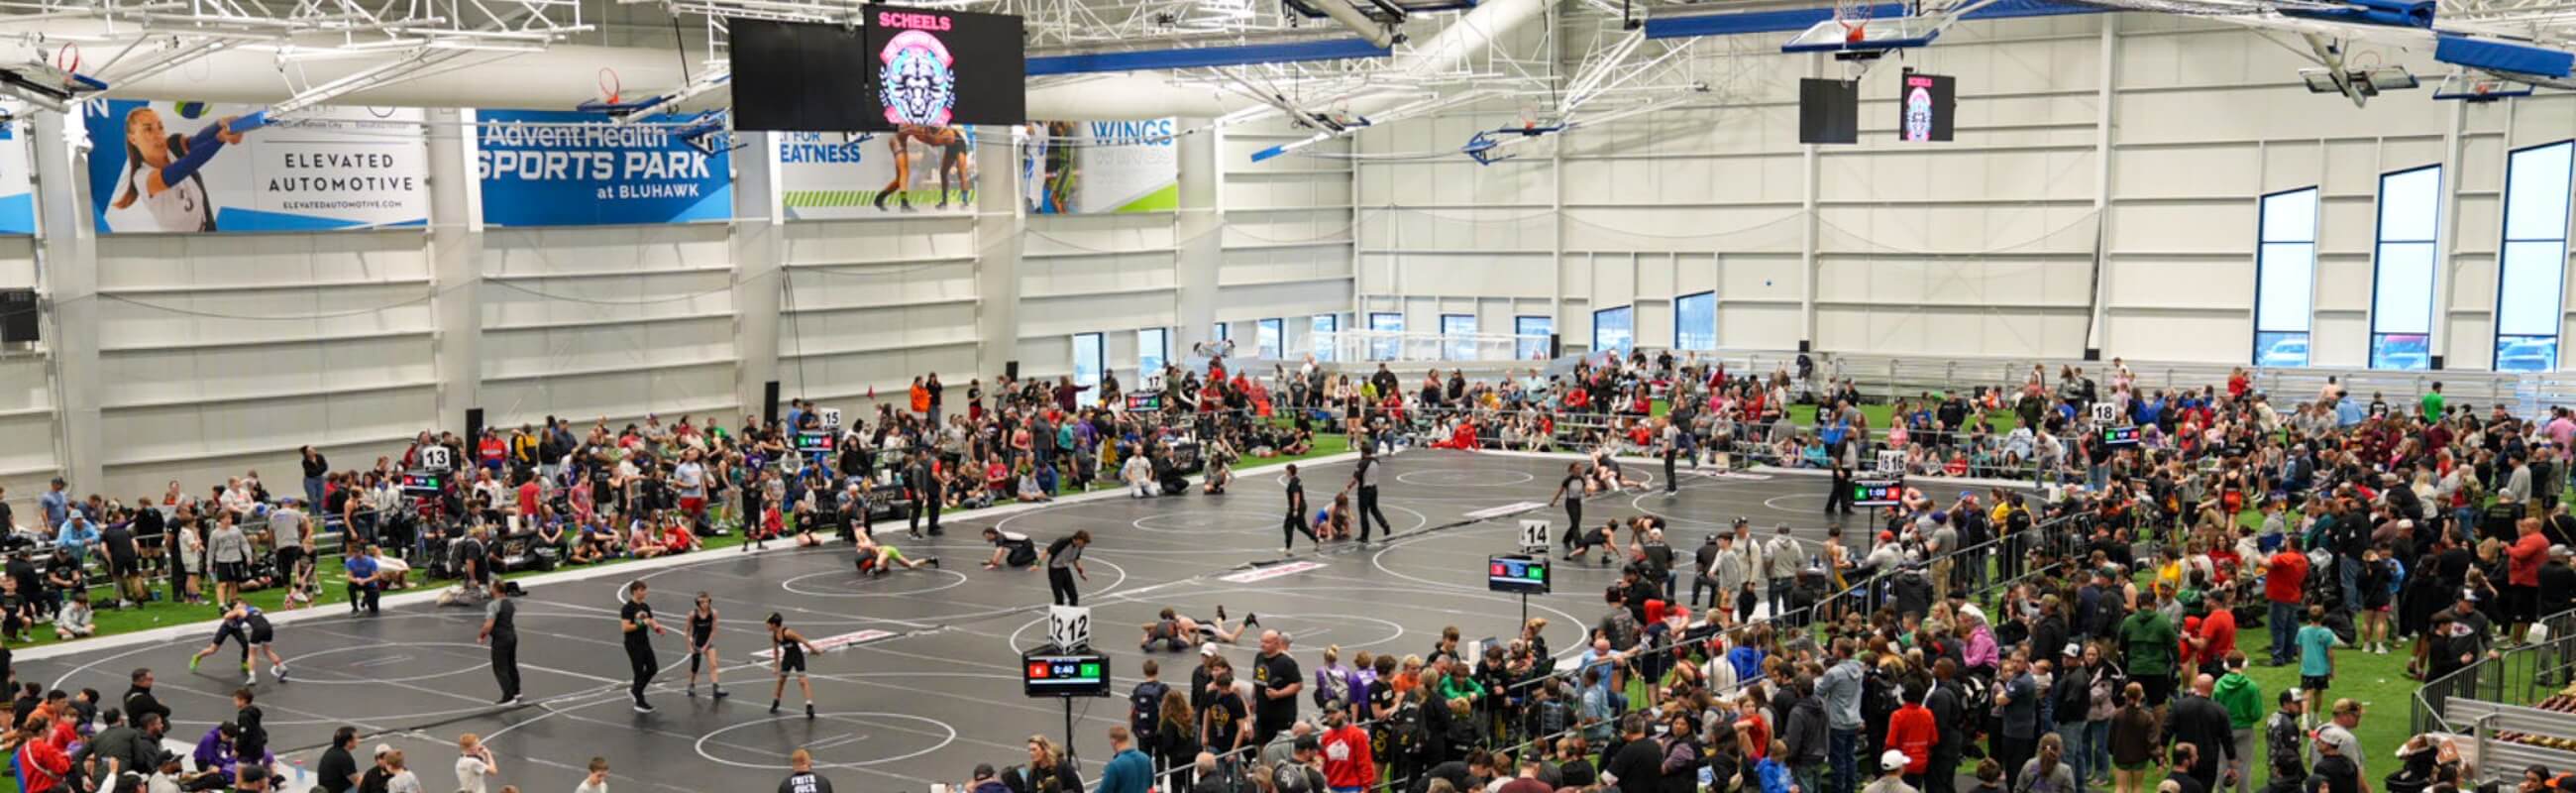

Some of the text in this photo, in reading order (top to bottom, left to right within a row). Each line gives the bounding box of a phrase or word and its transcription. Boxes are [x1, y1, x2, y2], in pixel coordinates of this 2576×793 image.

[879, 12, 952, 31] SCHEELS
[483, 119, 668, 148] AdventHealth
[1091, 119, 1173, 147] WINGS
[284, 153, 394, 169] ELEVATED
[479, 151, 710, 180] SPORTS PARK
[268, 176, 413, 192] AUTOMOTIVE
[596, 182, 699, 199] at BLUHAWK
[282, 199, 403, 210] ELEVATEDAUTOMOTIVE.COM
[1148, 376, 1160, 388] 17
[825, 411, 839, 424] 15
[2095, 405, 2112, 419] 18
[427, 450, 447, 465] 13
[1892, 455, 1904, 470] 16
[1527, 524, 1548, 544] 14
[1050, 614, 1063, 641] 12
[1068, 615, 1087, 641] 12
